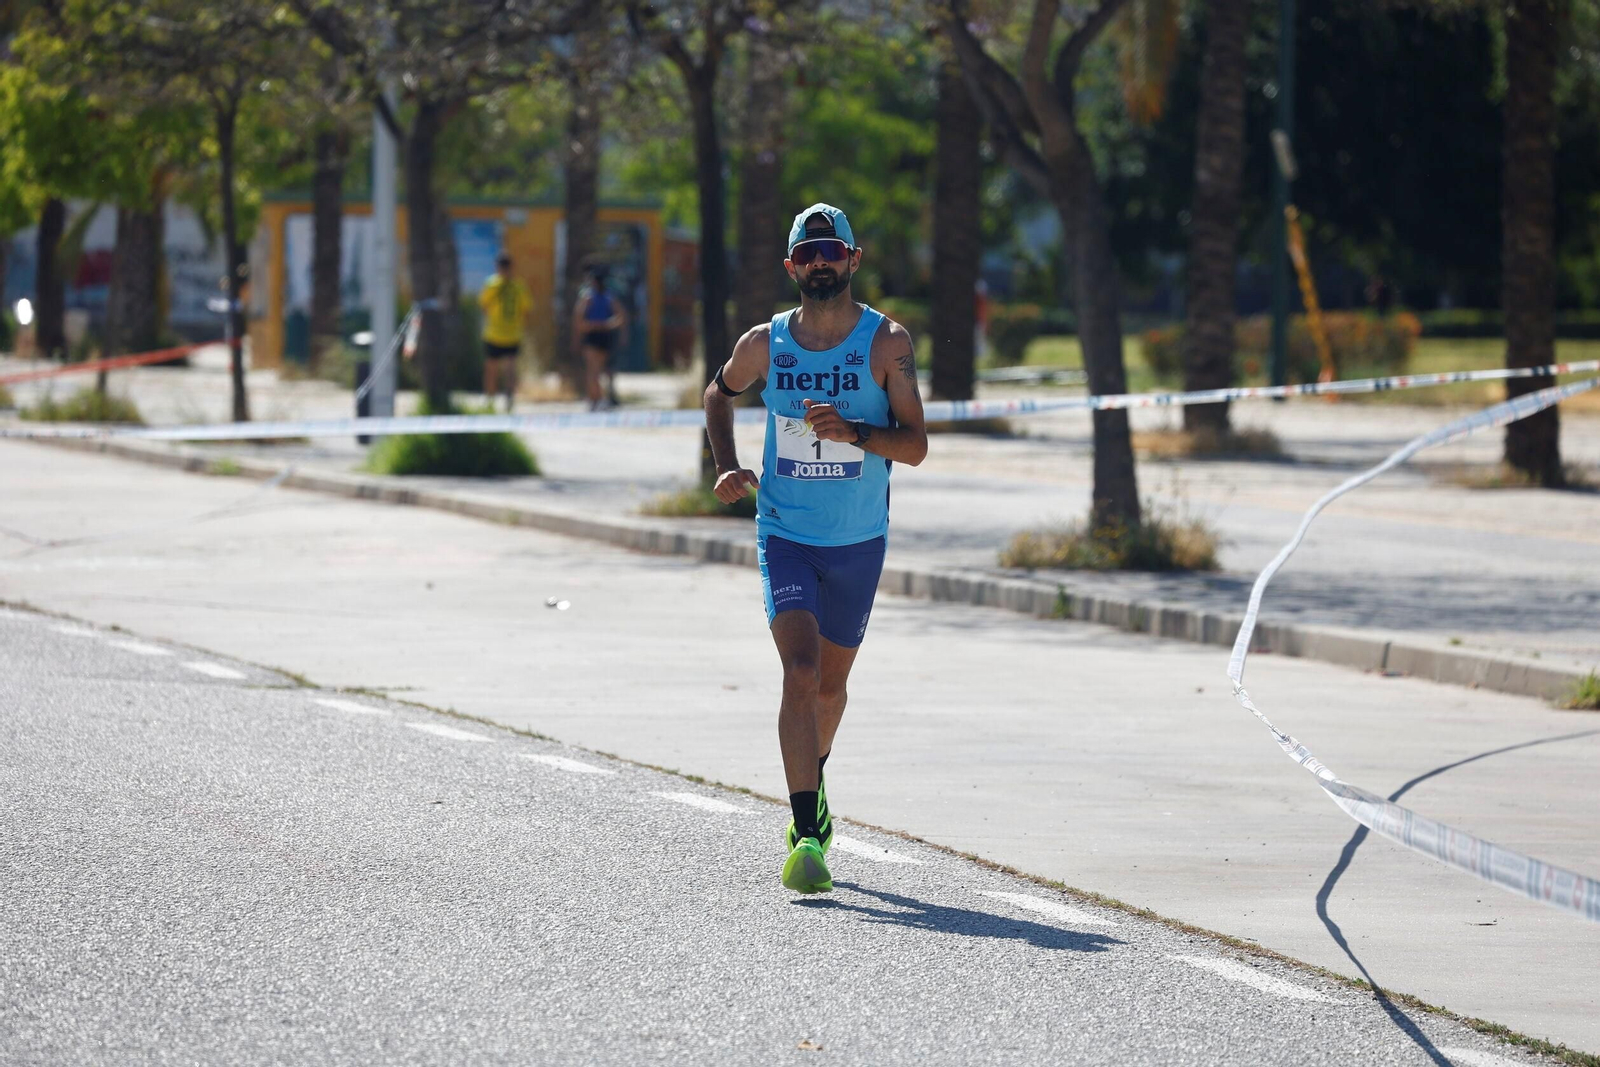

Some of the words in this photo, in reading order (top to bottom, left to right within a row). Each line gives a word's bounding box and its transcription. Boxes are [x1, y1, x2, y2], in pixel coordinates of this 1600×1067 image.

[775, 355, 797, 366] TROPS
[776, 365, 860, 397] nerja
[811, 440, 822, 460] 1
[773, 584, 803, 596] nerja
